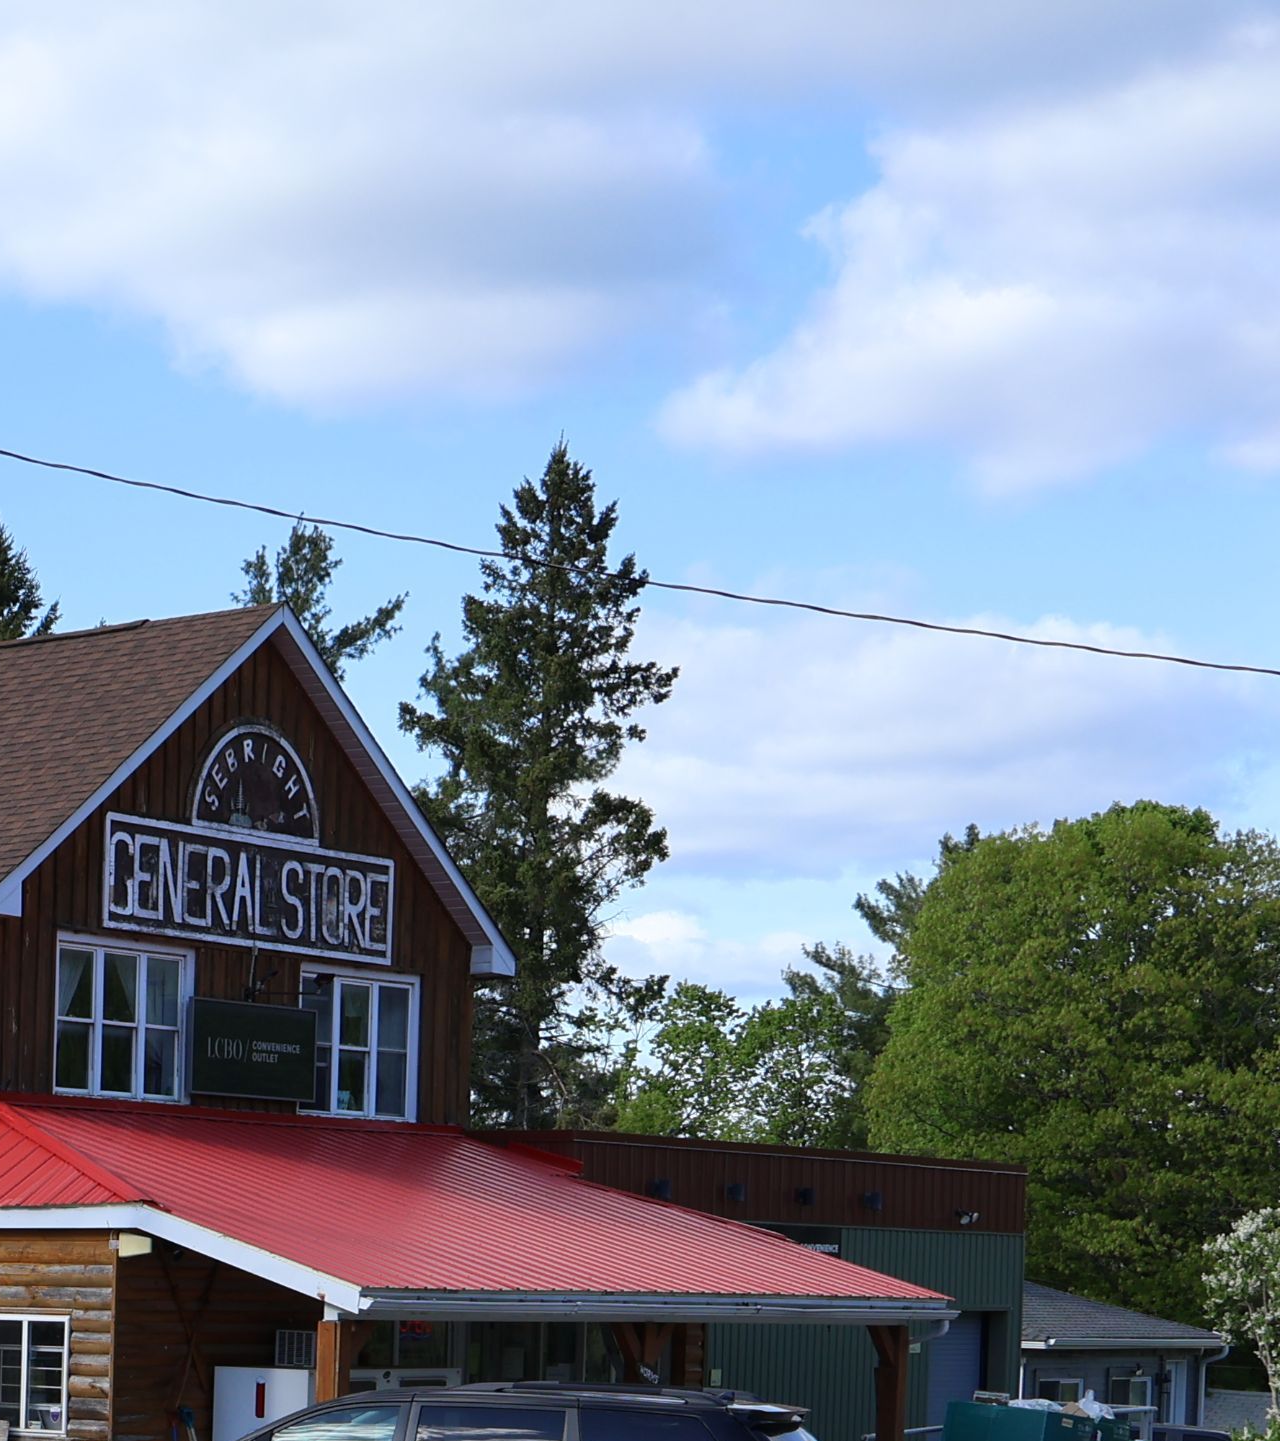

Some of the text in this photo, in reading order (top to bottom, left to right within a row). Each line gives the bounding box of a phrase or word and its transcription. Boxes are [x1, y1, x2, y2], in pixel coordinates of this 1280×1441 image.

[203, 737, 311, 822] SEBRIGHT
[109, 830, 390, 953] GENERAL STORE
[207, 1036, 243, 1060] LCBO
[252, 1040, 300, 1054] CONVENIENCE
[252, 1052, 278, 1063] OUTLET
[800, 1243, 839, 1253] NVENIENCE
